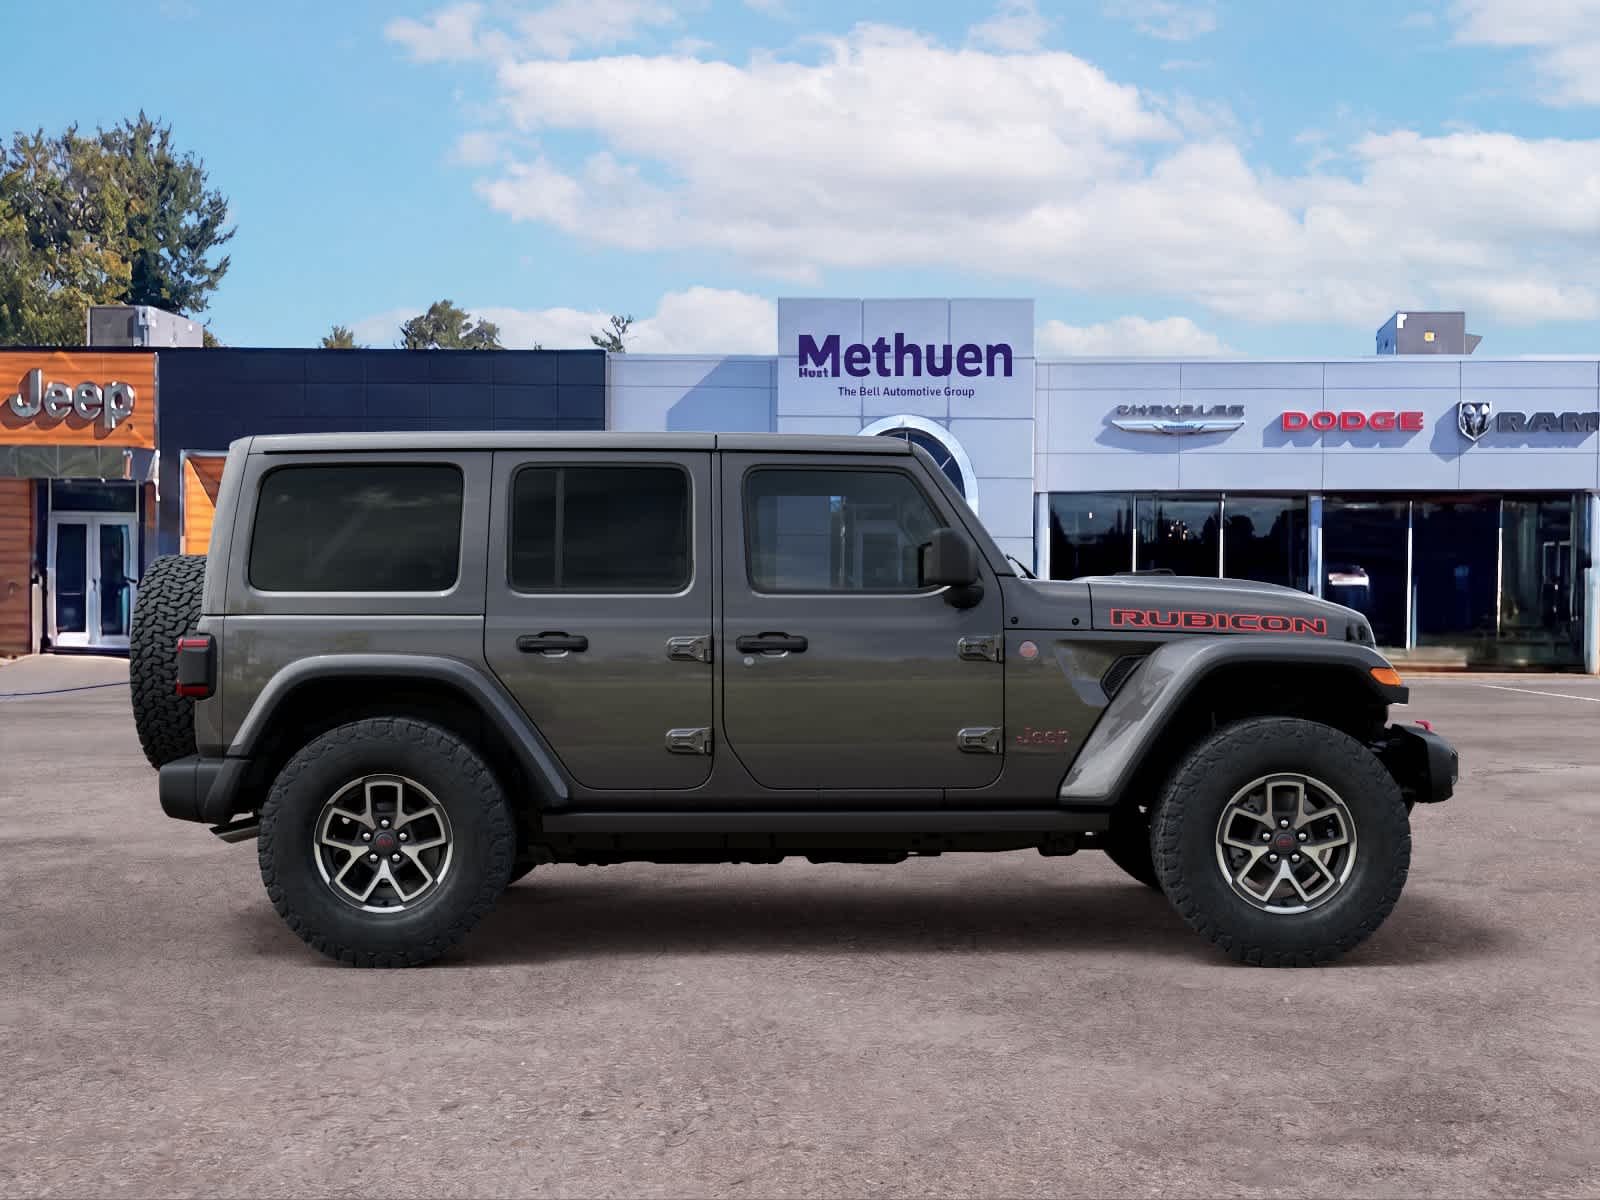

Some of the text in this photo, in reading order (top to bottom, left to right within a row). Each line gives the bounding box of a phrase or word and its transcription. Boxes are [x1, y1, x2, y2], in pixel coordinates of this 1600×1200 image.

[798, 332, 1013, 378] Methuen
[8, 368, 136, 429] Jeep
[838, 386, 975, 399] The Bell Automotive Group
[1282, 411, 1423, 432] DODGE
[1497, 411, 1600, 433] RAM
[1110, 608, 1328, 635] RUBICON
